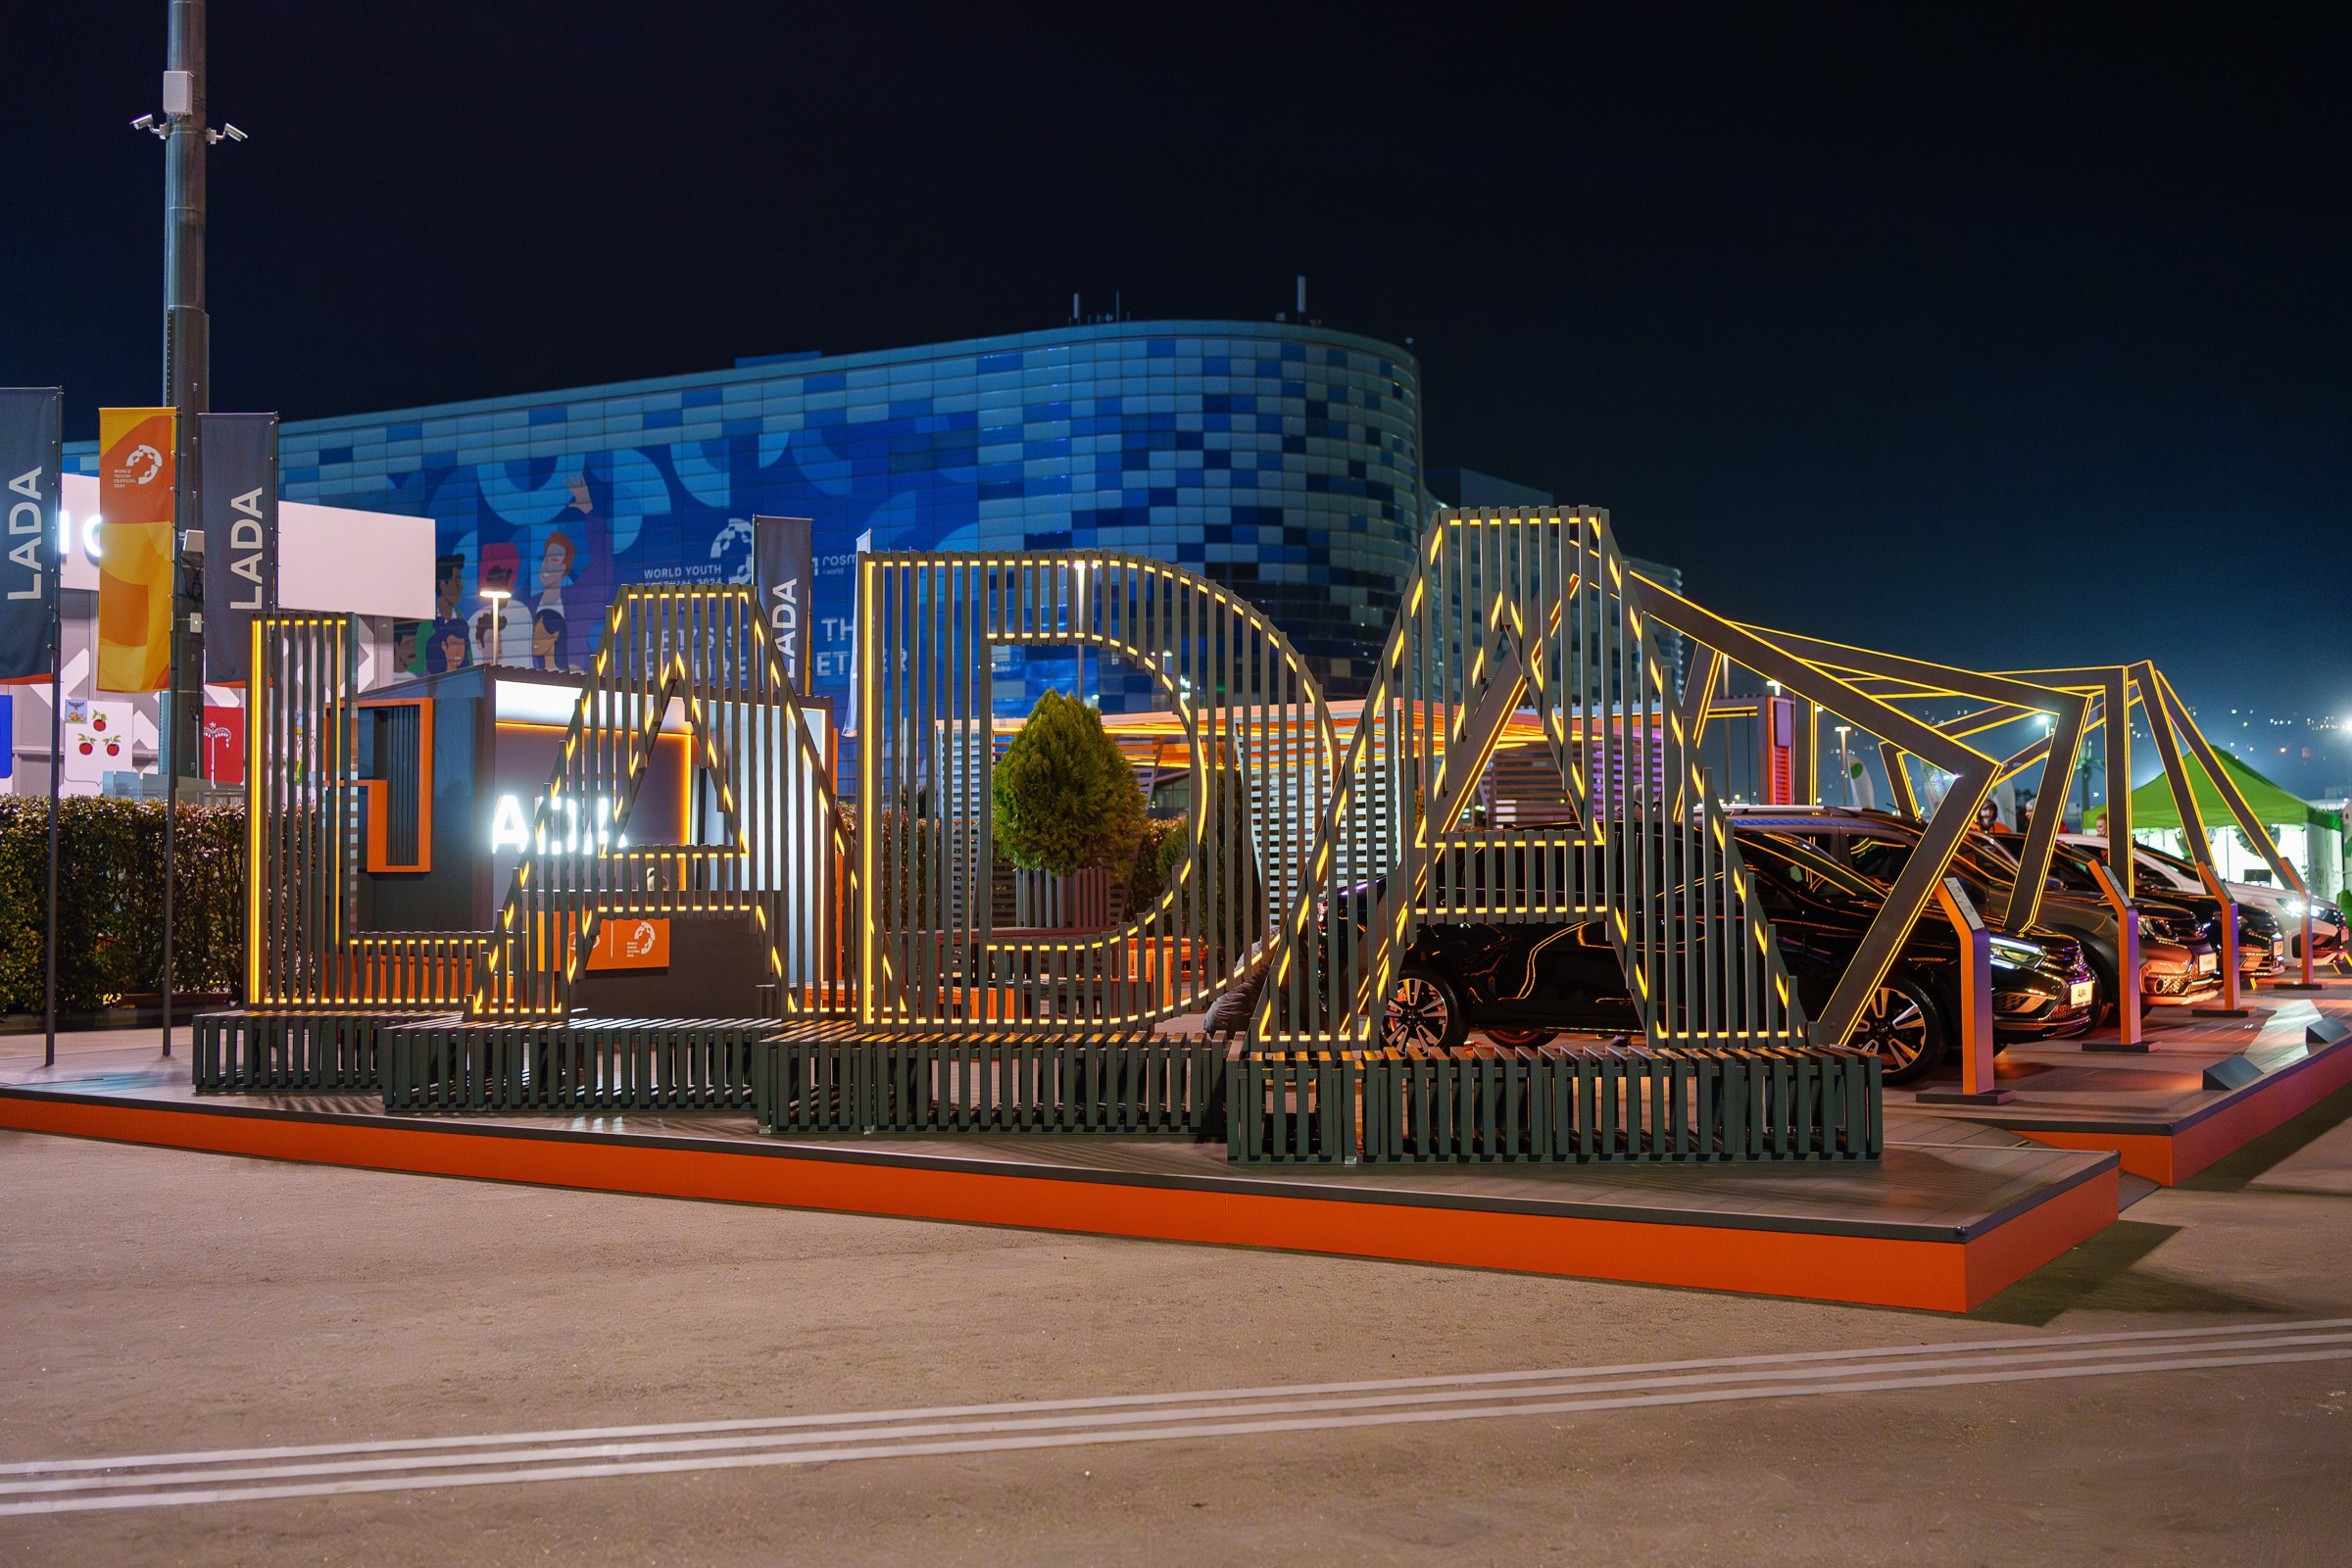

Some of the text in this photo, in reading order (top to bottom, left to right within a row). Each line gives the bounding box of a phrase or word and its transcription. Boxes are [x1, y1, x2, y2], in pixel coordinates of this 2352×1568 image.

[7, 466, 42, 600] LADA
[229, 487, 263, 610] LADA
[644, 564, 722, 579] WORLD YOUTH
